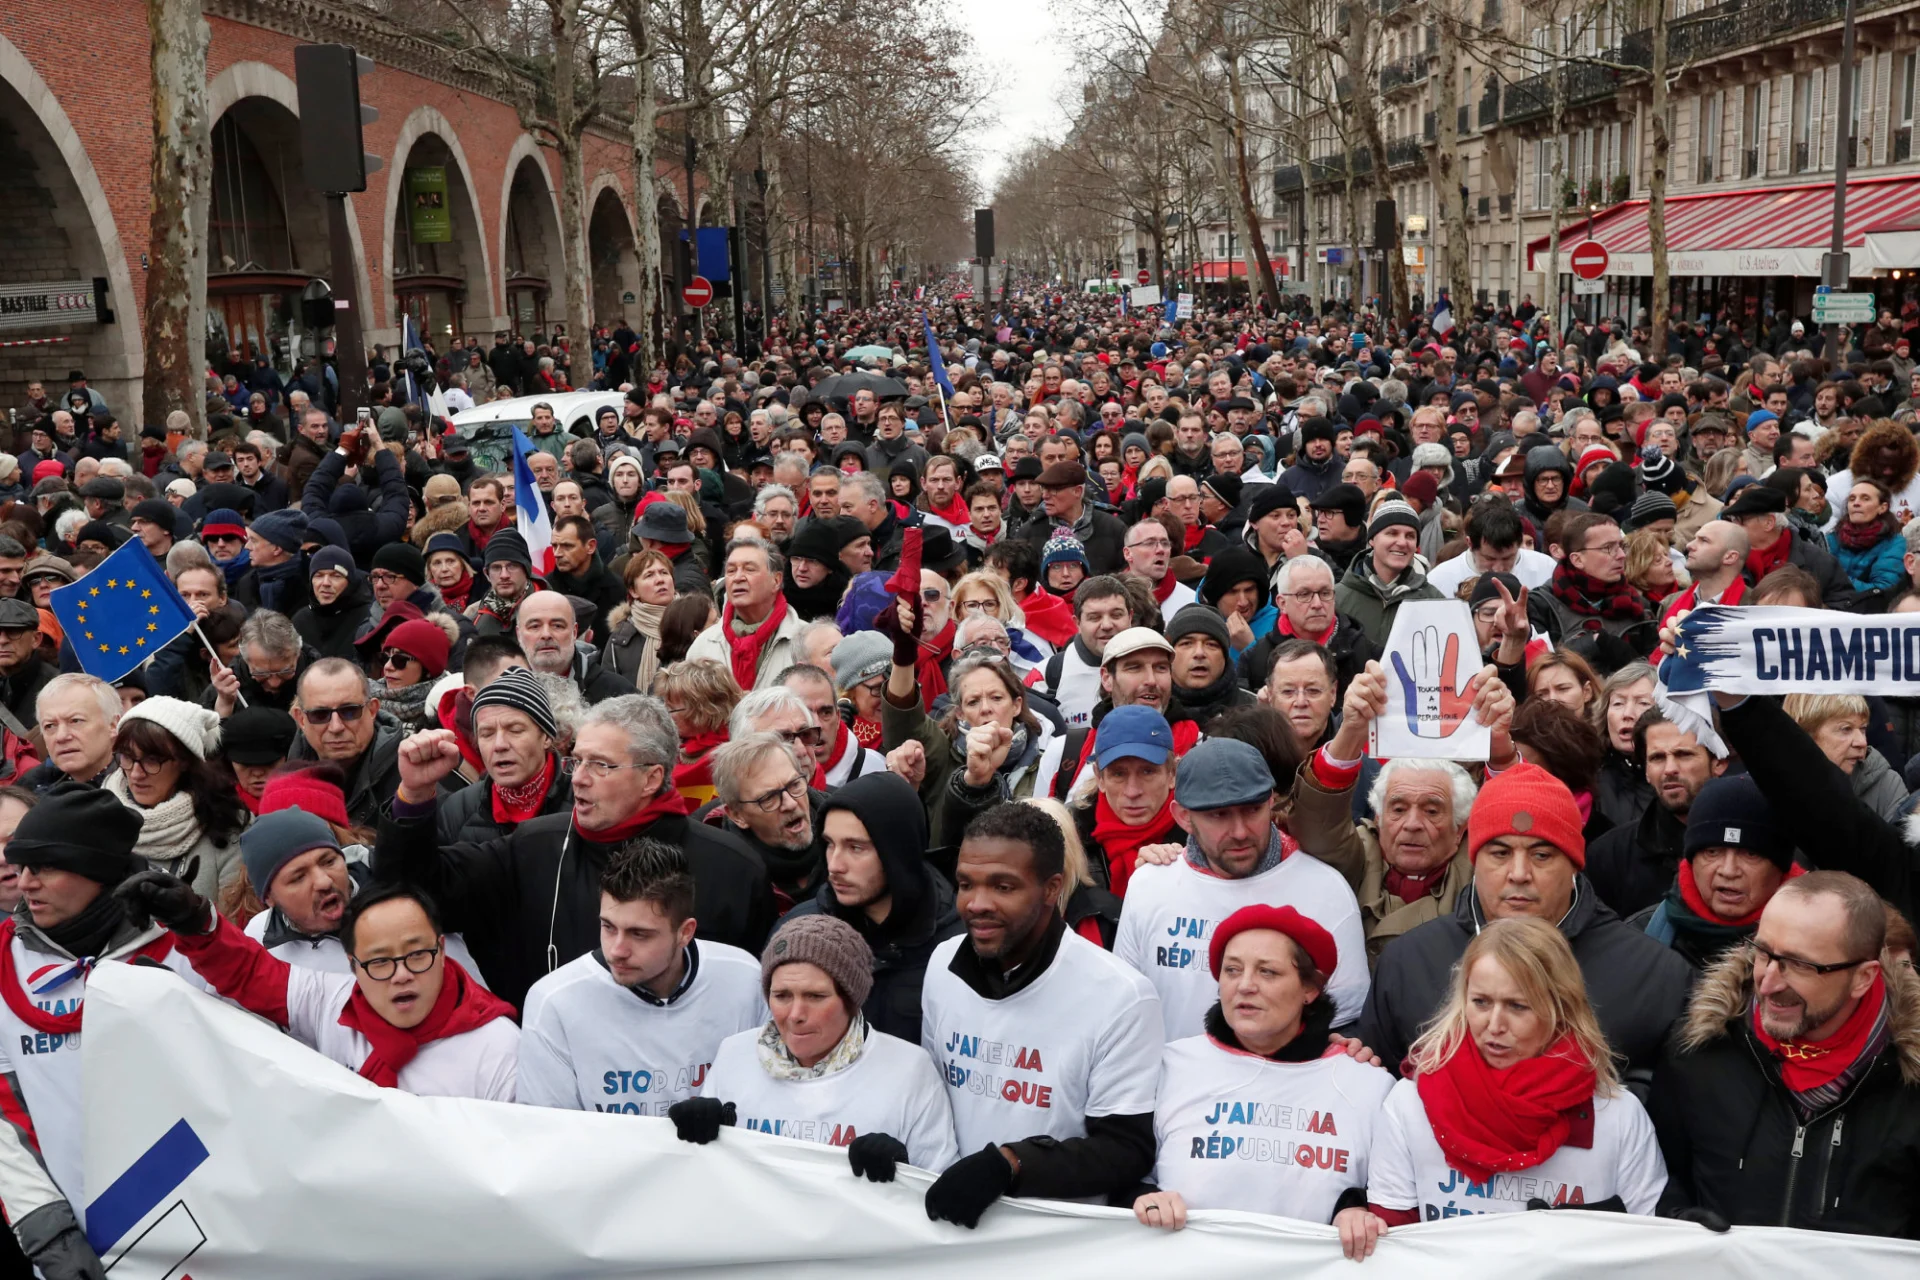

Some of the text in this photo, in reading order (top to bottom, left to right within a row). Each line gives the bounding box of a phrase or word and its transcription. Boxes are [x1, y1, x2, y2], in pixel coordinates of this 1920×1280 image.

[1417, 685, 1442, 693] TOUCHE
[946, 1031, 1043, 1073] J'AIME MA
[603, 1062, 712, 1095] STOP AU
[942, 1058, 1052, 1108] RÉPUBLIQUE
[818, 1121, 857, 1148] MA
[1204, 1101, 1338, 1136] J'AIME MA
[1190, 1129, 1350, 1173] RÉPUBLIQUE
[1541, 1180, 1585, 1207] MA
